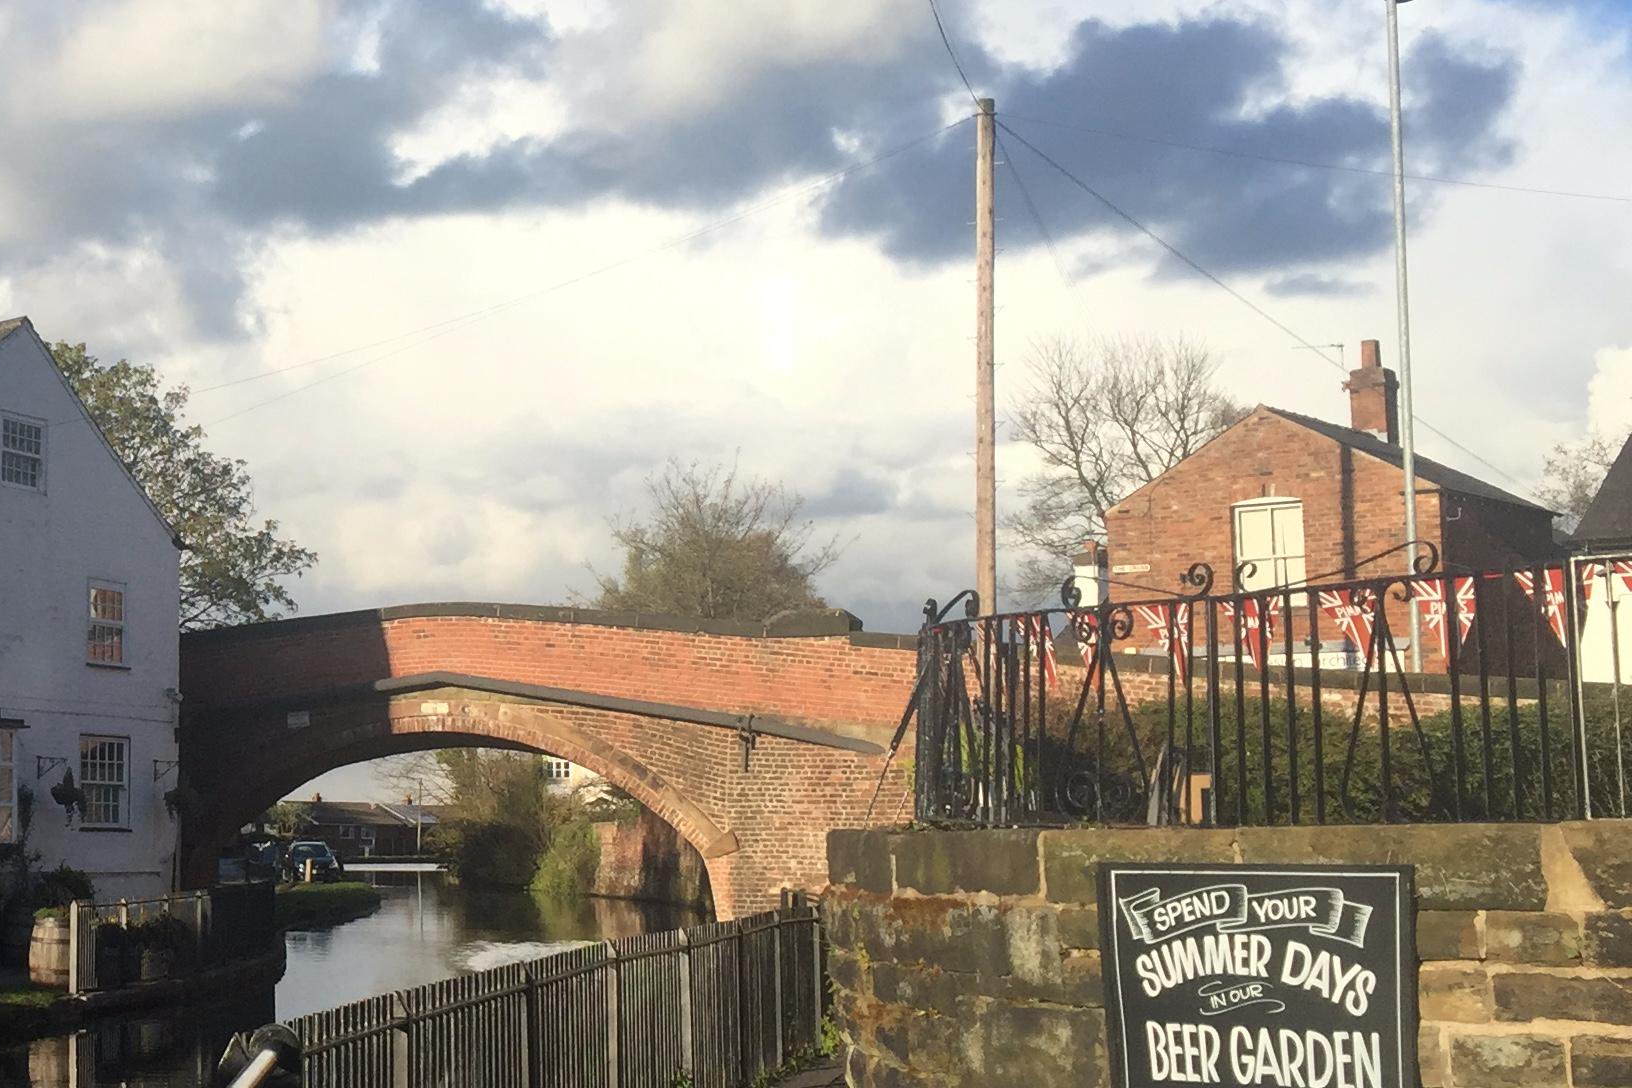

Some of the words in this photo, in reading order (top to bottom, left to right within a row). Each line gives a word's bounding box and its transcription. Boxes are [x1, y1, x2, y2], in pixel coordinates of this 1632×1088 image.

[1154, 890, 1231, 931] SPEND
[1252, 895, 1317, 924] YOUR
[1136, 934, 1272, 998] SUMMER
[1281, 940, 1377, 1017] DAYS
[1210, 994, 1227, 1009] IN
[1230, 984, 1264, 1001] OUR
[1146, 1020, 1221, 1083] BEER
[1230, 1025, 1382, 1088] GARDEN
